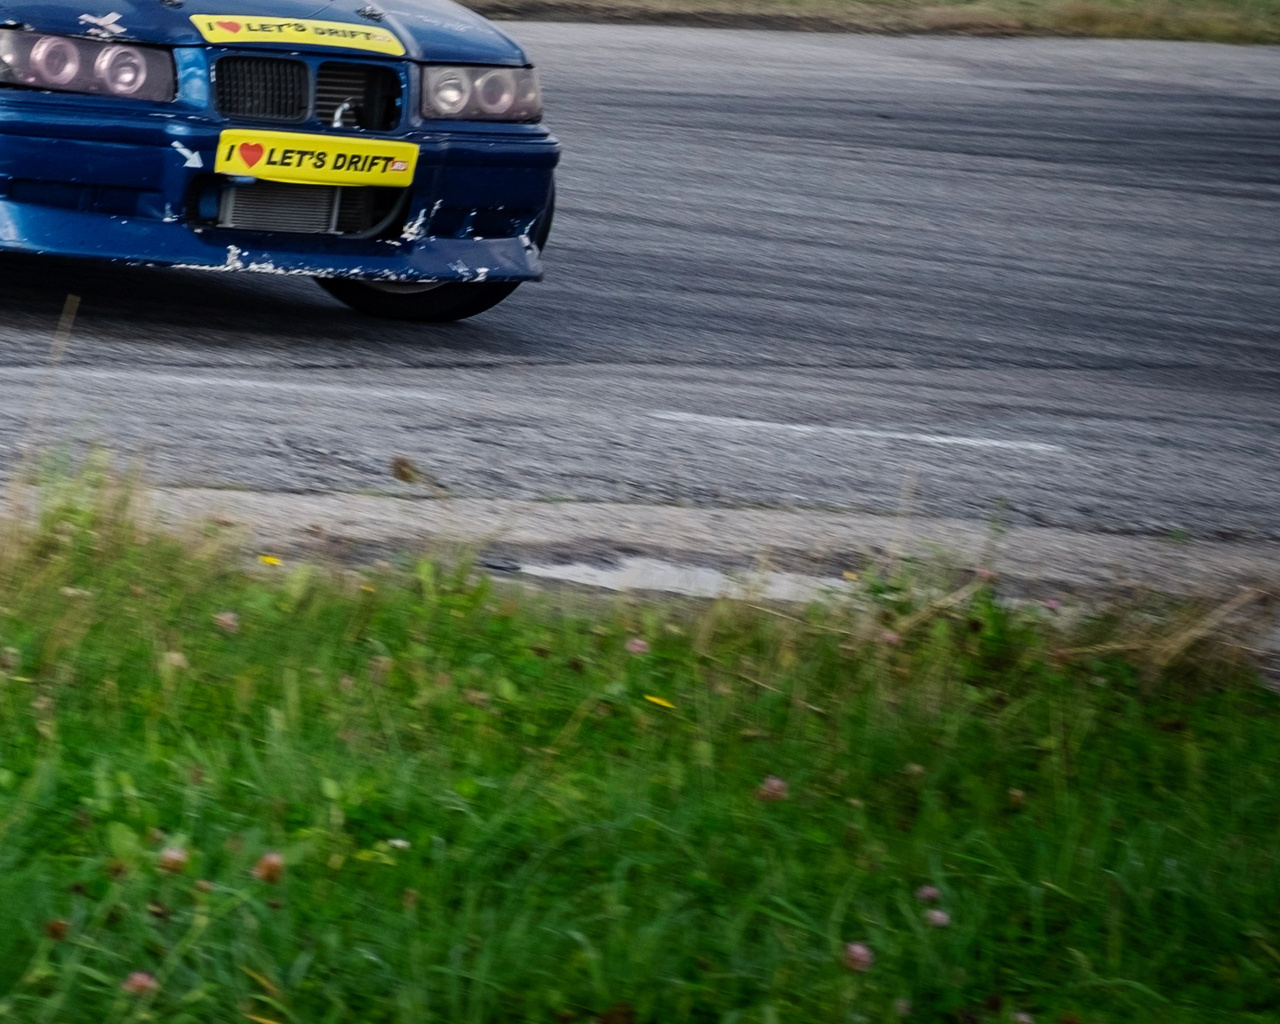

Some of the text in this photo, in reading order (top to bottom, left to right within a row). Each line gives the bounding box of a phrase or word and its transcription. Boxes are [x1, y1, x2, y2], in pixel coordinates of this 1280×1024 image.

[225, 144, 235, 162] I
[265, 148, 329, 169] LET'S
[332, 153, 396, 174] DRIFT
